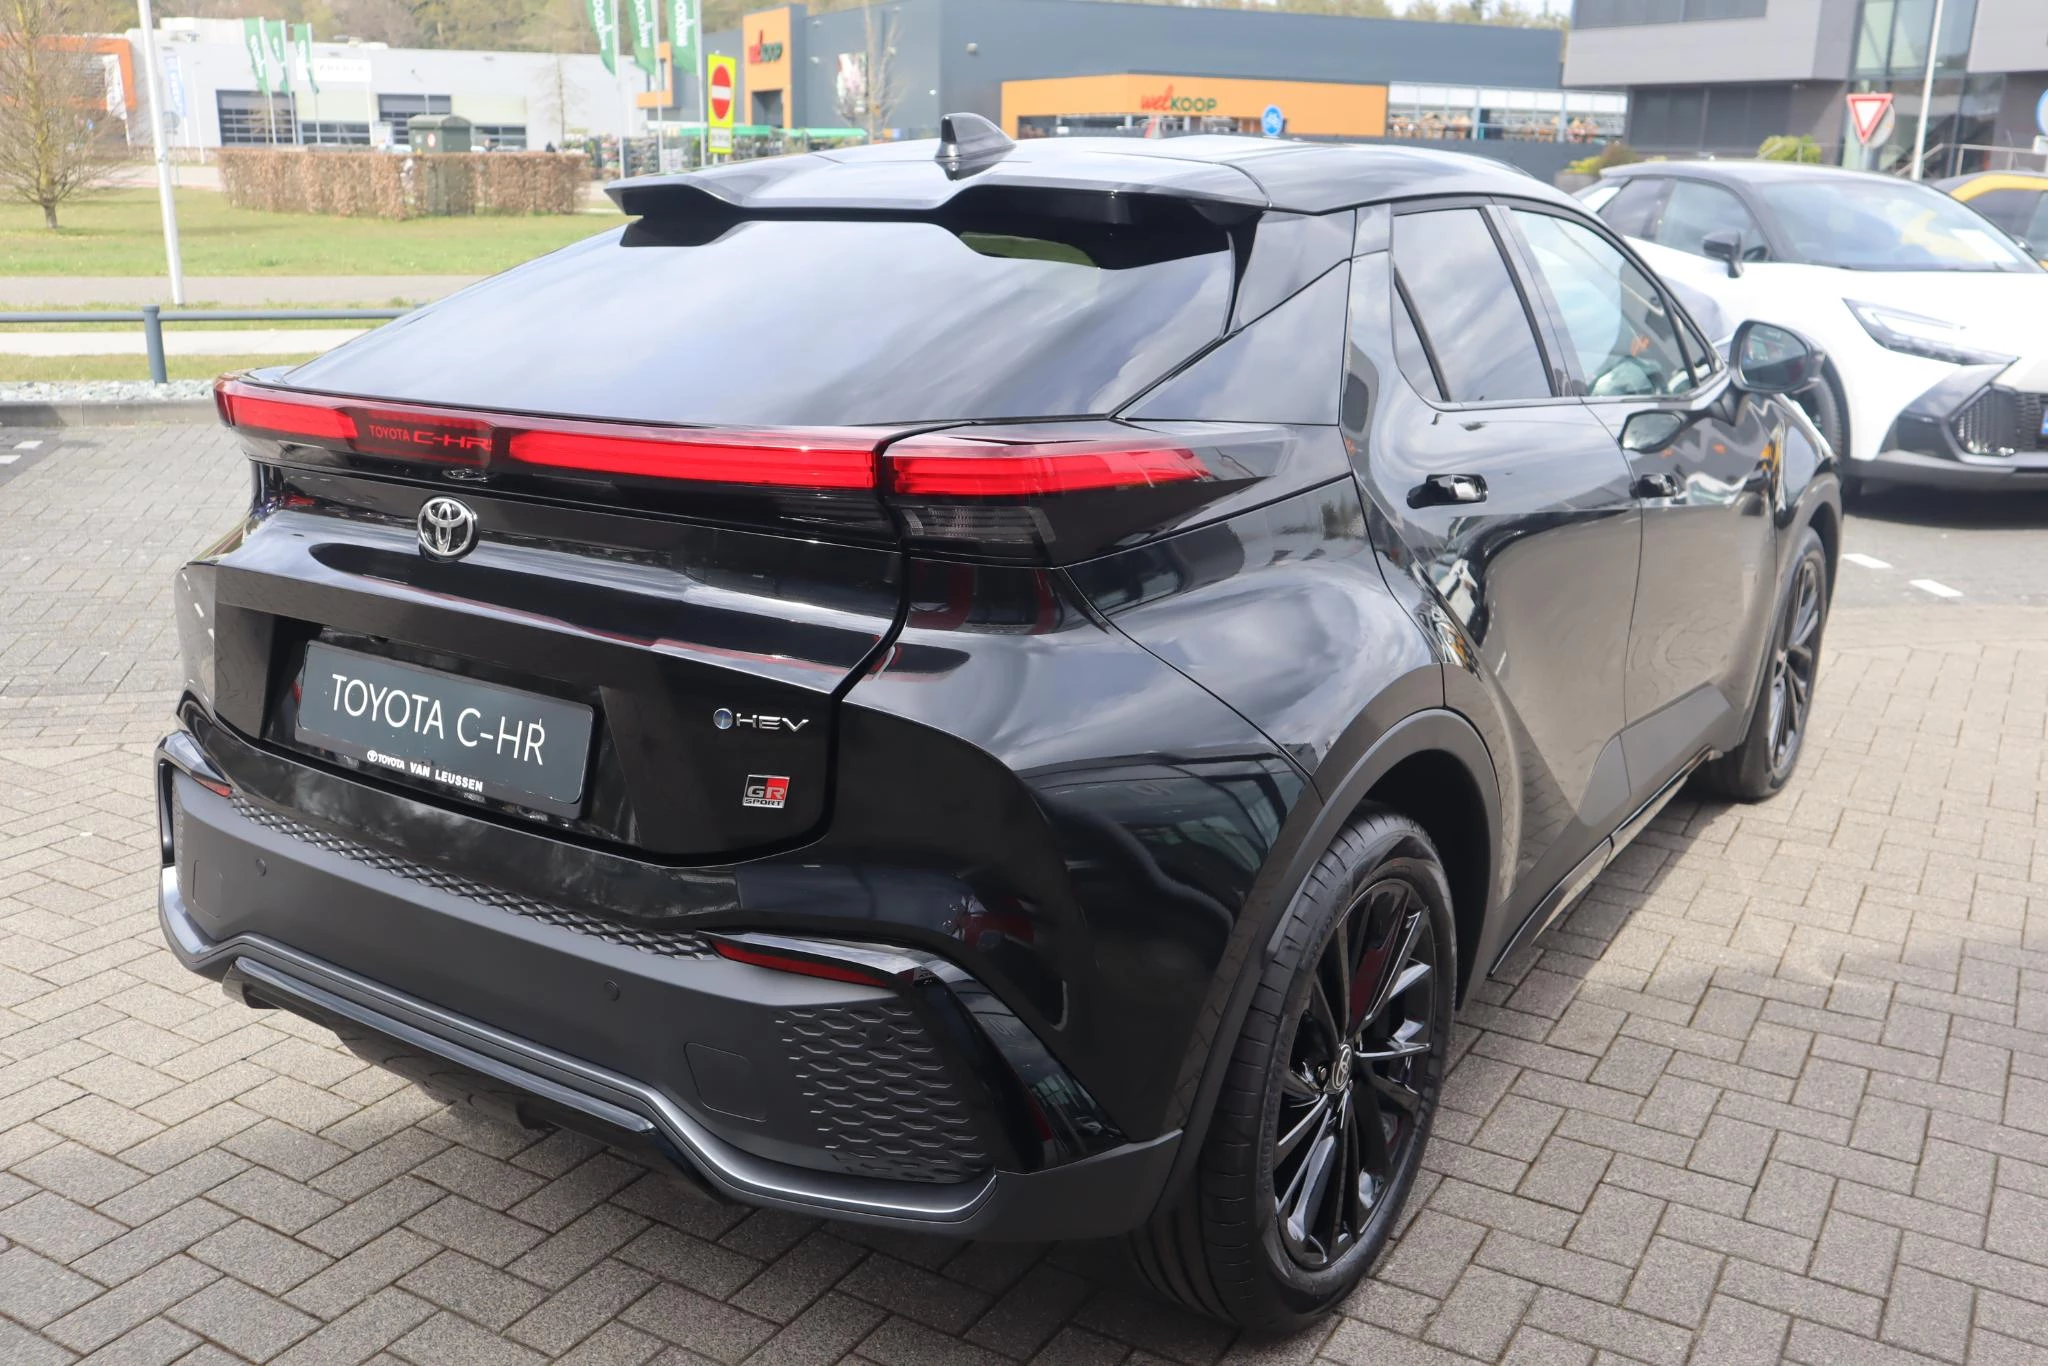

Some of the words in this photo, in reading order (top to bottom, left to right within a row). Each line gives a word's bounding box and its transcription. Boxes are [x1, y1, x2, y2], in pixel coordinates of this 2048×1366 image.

[368, 424, 410, 441] TOYOTA
[413, 430, 492, 451] C-HR
[331, 673, 444, 739] TOYOTA
[456, 707, 546, 765] C-HR
[736, 713, 809, 732] HEV
[377, 754, 405, 769] TOYOTA
[410, 762, 430, 777] VAN
[435, 769, 483, 792] LEUSSEN
[745, 798, 782, 806] SPORT
[747, 785, 785, 800] GR
